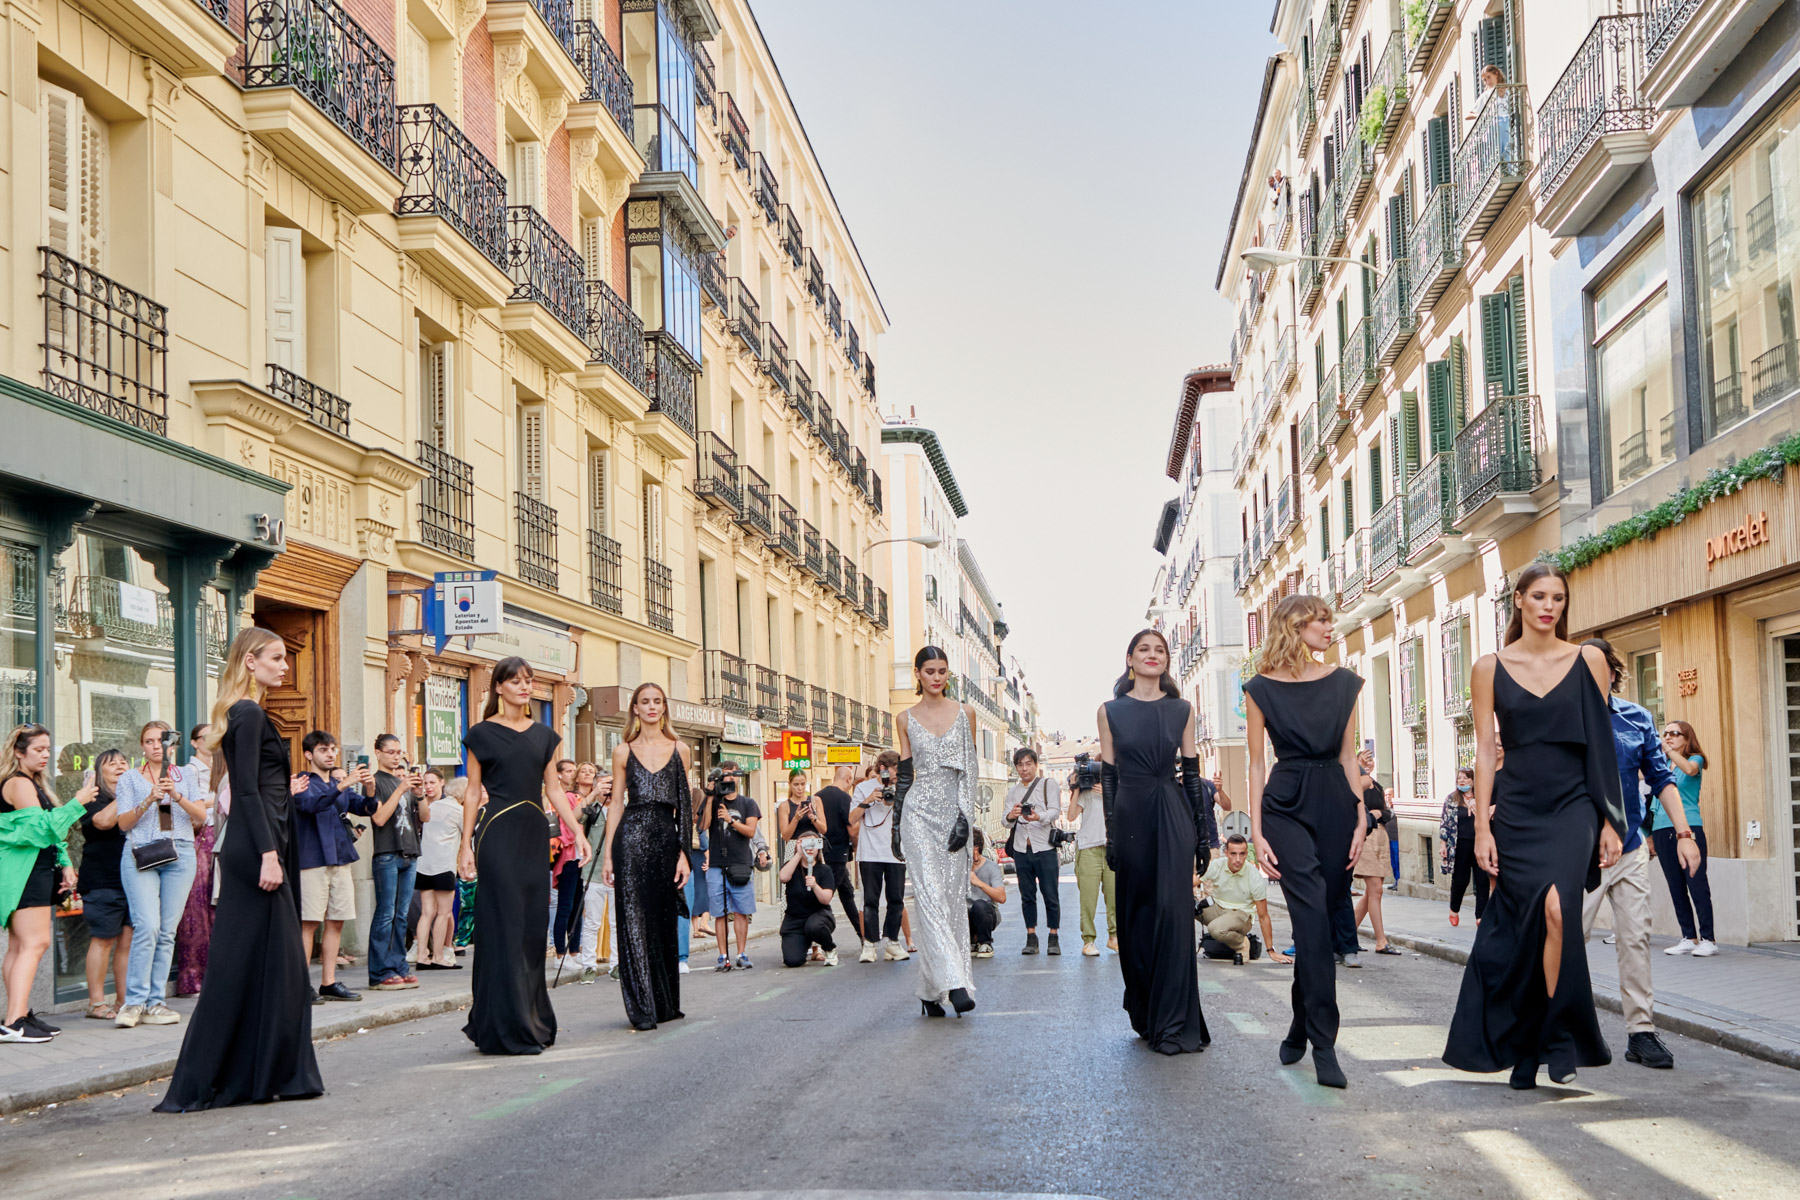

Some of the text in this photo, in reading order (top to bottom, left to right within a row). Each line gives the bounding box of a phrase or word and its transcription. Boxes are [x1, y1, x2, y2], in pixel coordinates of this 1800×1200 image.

[254, 513, 285, 546] 30
[1706, 511, 1769, 571] poncelet
[1678, 668, 1697, 681] CHEESE
[429, 688, 456, 709] Navidad
[1679, 681, 1698, 697] SHOP
[676, 703, 716, 725] ARGENSOLA
